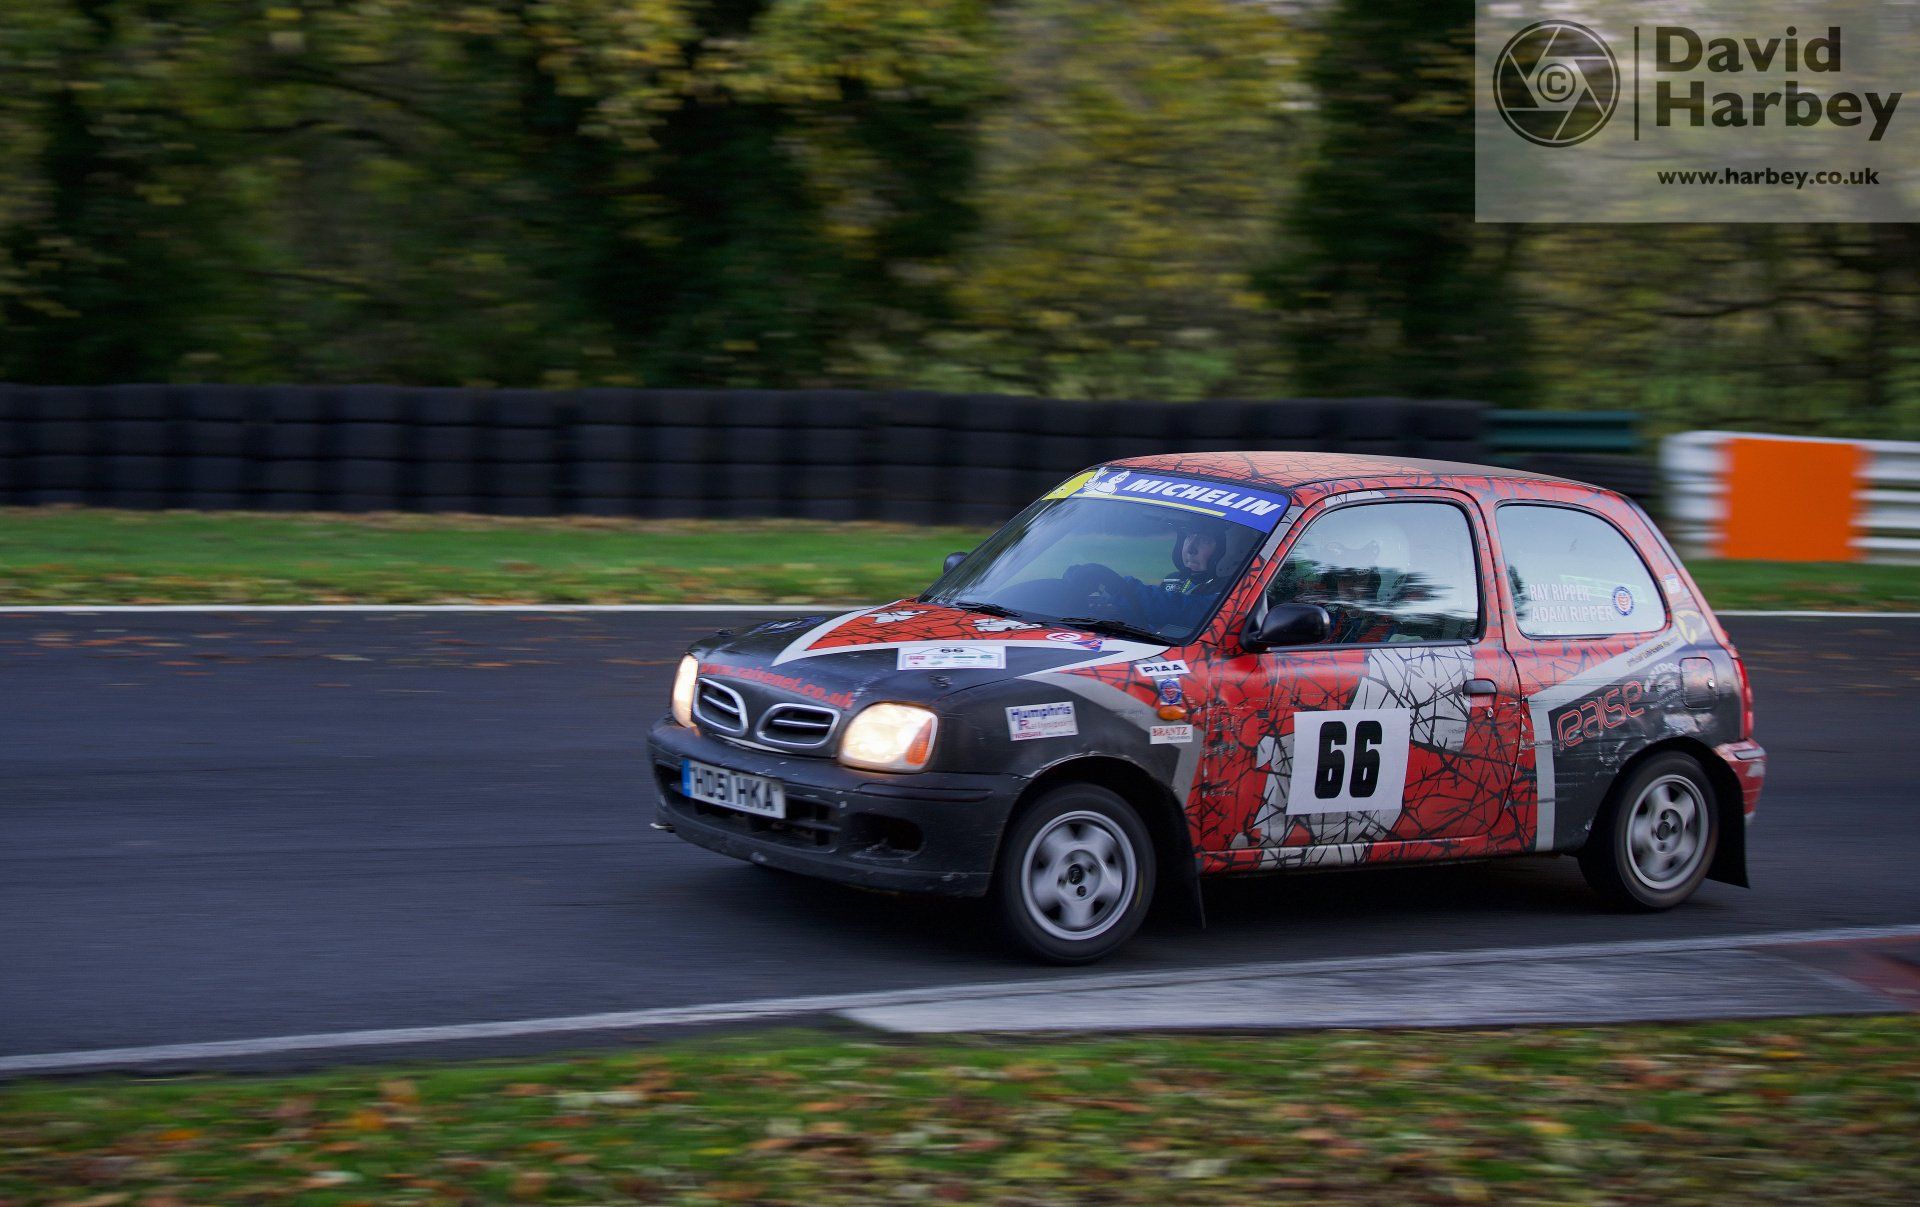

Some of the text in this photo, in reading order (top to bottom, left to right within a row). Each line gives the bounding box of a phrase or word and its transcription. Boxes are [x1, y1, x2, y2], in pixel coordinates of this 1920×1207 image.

[1123, 478, 1281, 516] MICHELIN
[1529, 584, 1591, 602] RAY RIPPER
[1531, 605, 1615, 622] ADAM RIPPER
[1143, 664, 1183, 673] PIAA
[1011, 704, 1072, 721] Humphris
[1314, 720, 1383, 799] 66
